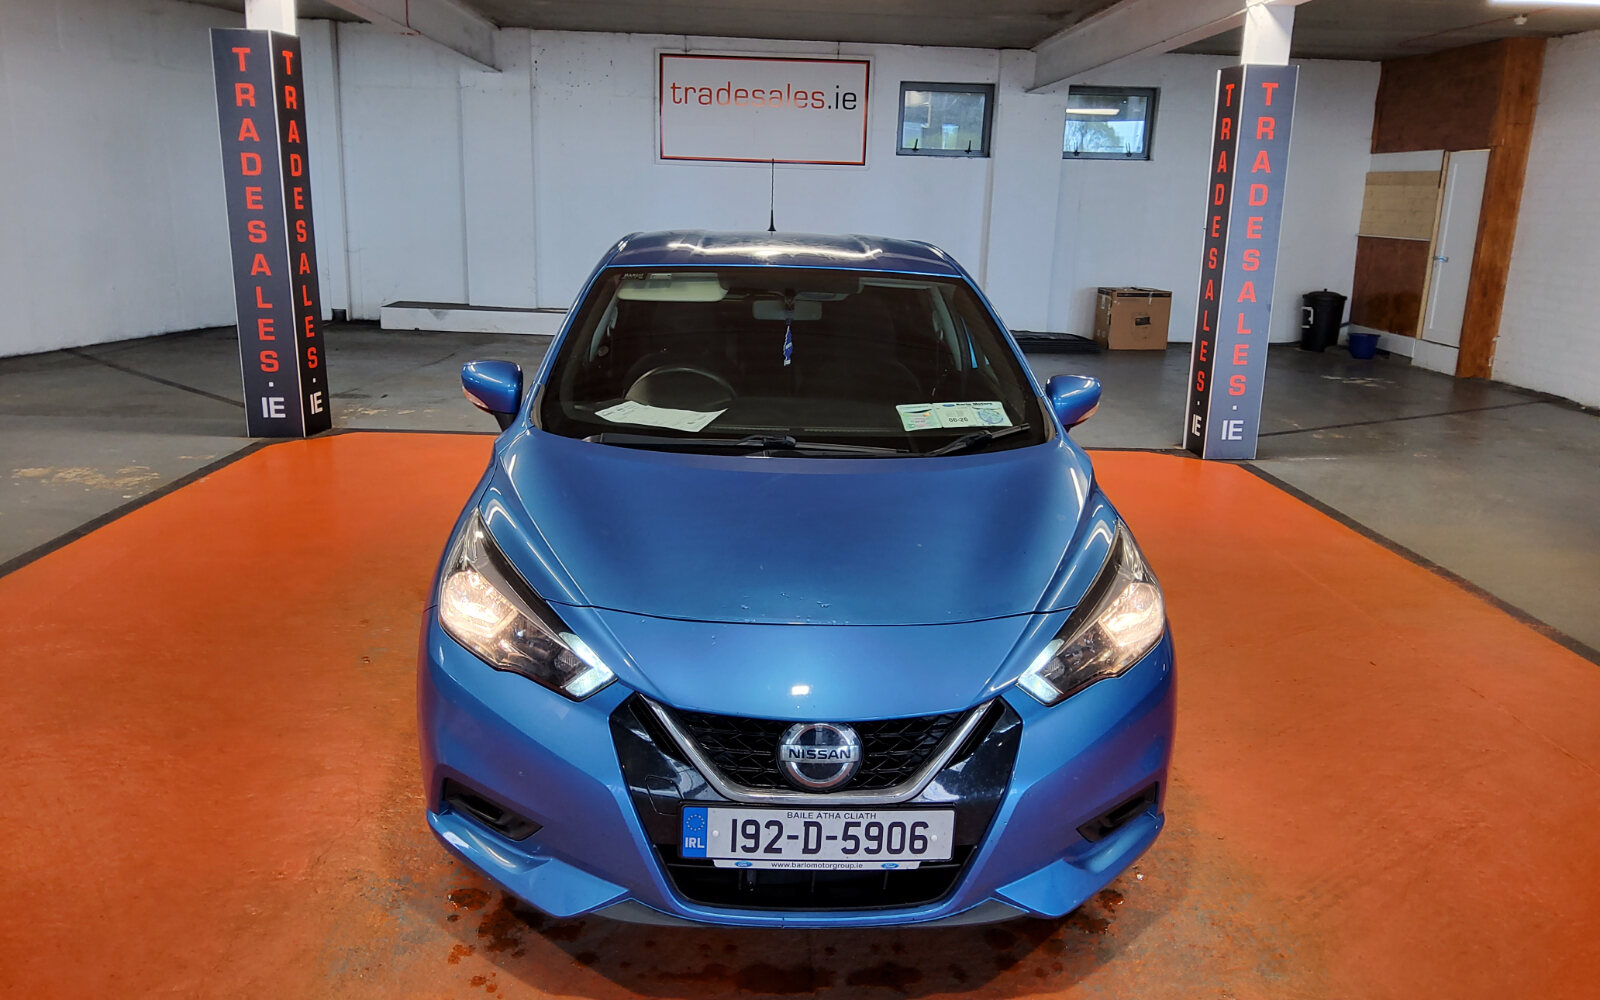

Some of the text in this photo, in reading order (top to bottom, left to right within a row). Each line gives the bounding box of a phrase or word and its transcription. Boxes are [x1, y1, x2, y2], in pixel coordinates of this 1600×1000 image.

[670, 81, 857, 110] tradesales.ie
[788, 748, 851, 760] NISSAN
[816, 812, 842, 820] ATHA
[843, 812, 877, 820] CLIATH
[730, 818, 929, 855] 192-D-5906
[685, 837, 705, 849] IRL
